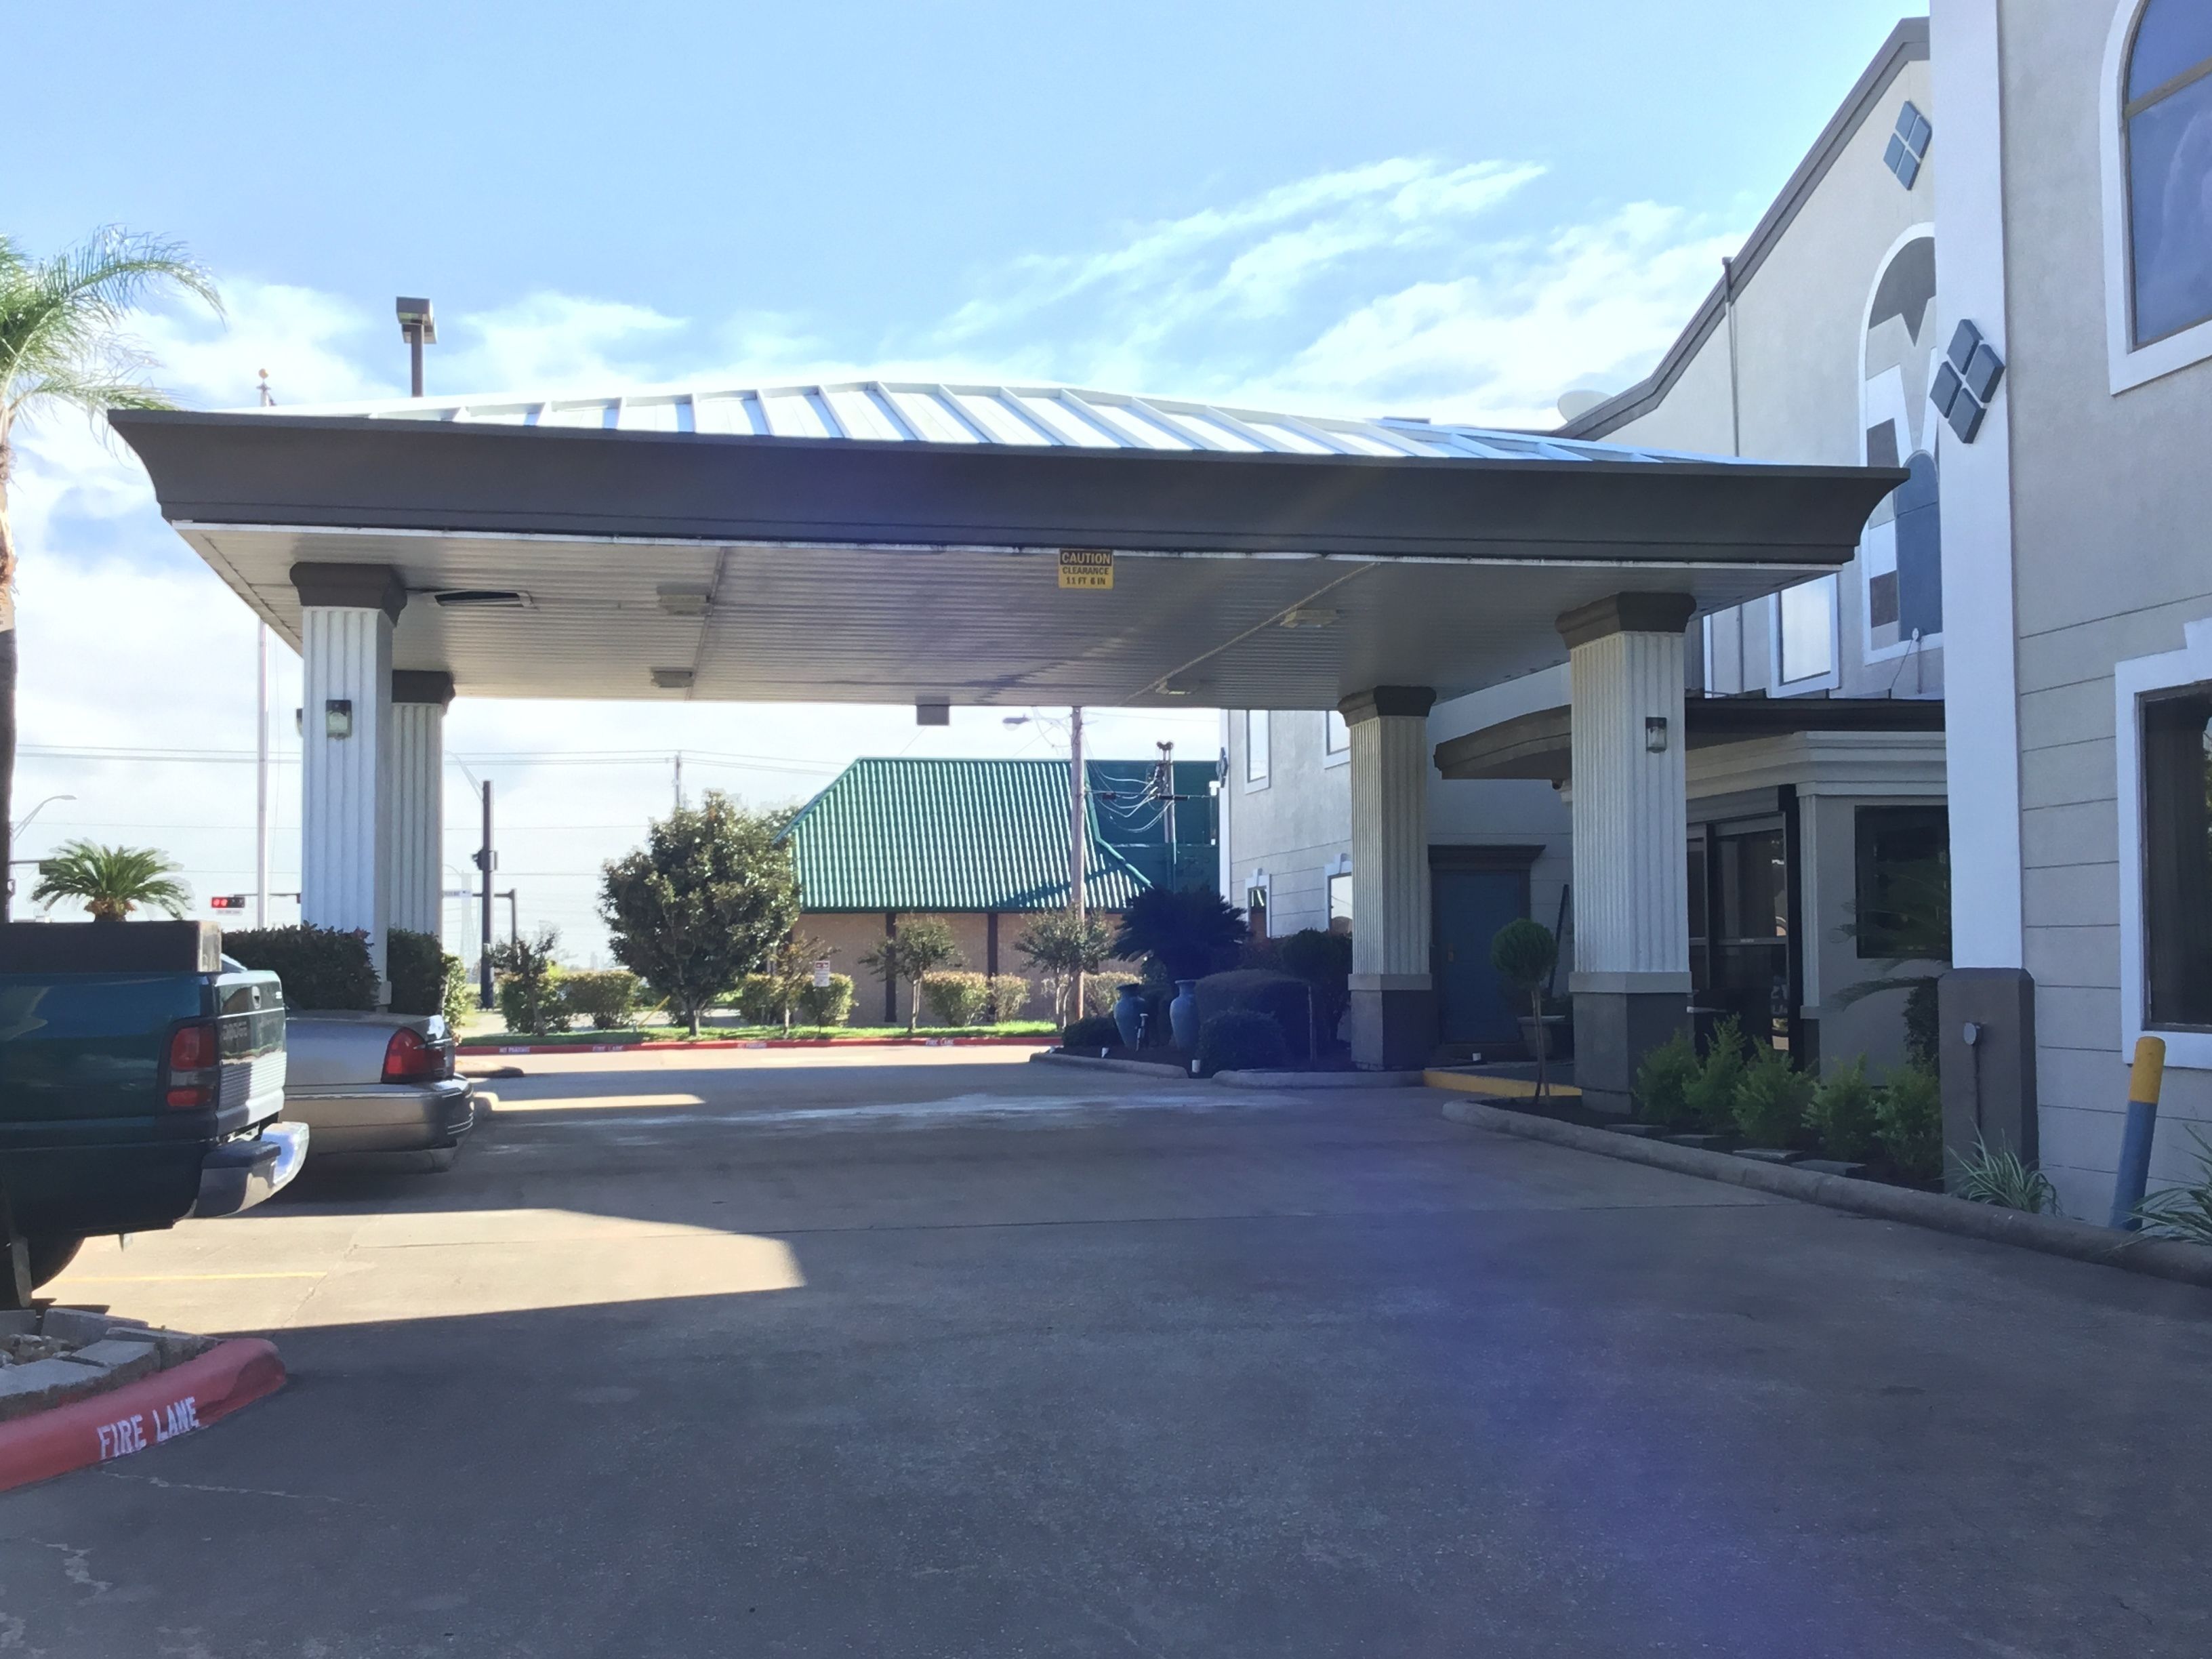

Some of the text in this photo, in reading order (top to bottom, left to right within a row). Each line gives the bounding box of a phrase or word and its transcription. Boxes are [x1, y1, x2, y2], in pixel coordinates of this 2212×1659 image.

[1061, 552, 1111, 564] CAUTION
[1062, 567, 1109, 575] CLEARANCE
[97, 1396, 200, 1460] FIRE LANE
